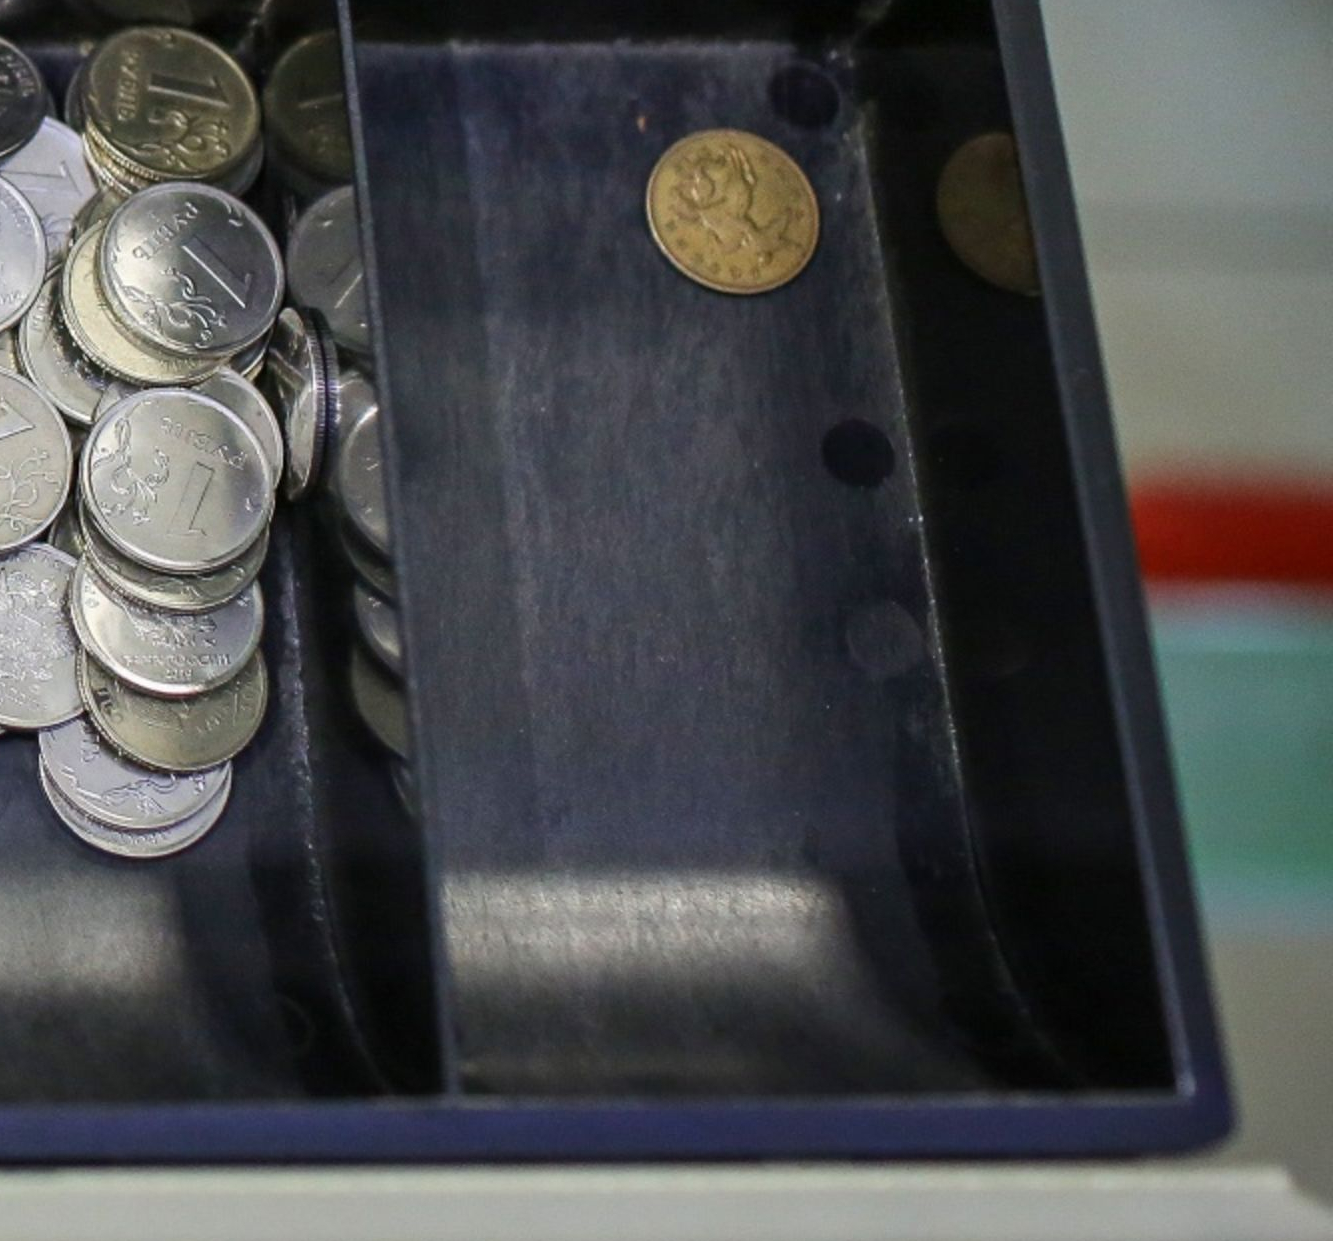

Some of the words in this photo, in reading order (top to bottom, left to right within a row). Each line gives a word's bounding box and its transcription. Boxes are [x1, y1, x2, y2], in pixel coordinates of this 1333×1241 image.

[145, 71, 231, 109] 1
[132, 201, 199, 262] РУБЛЬ
[180, 233, 254, 309] 1
[159, 415, 249, 472] РУБЛЬ
[166, 460, 216, 538] 1
